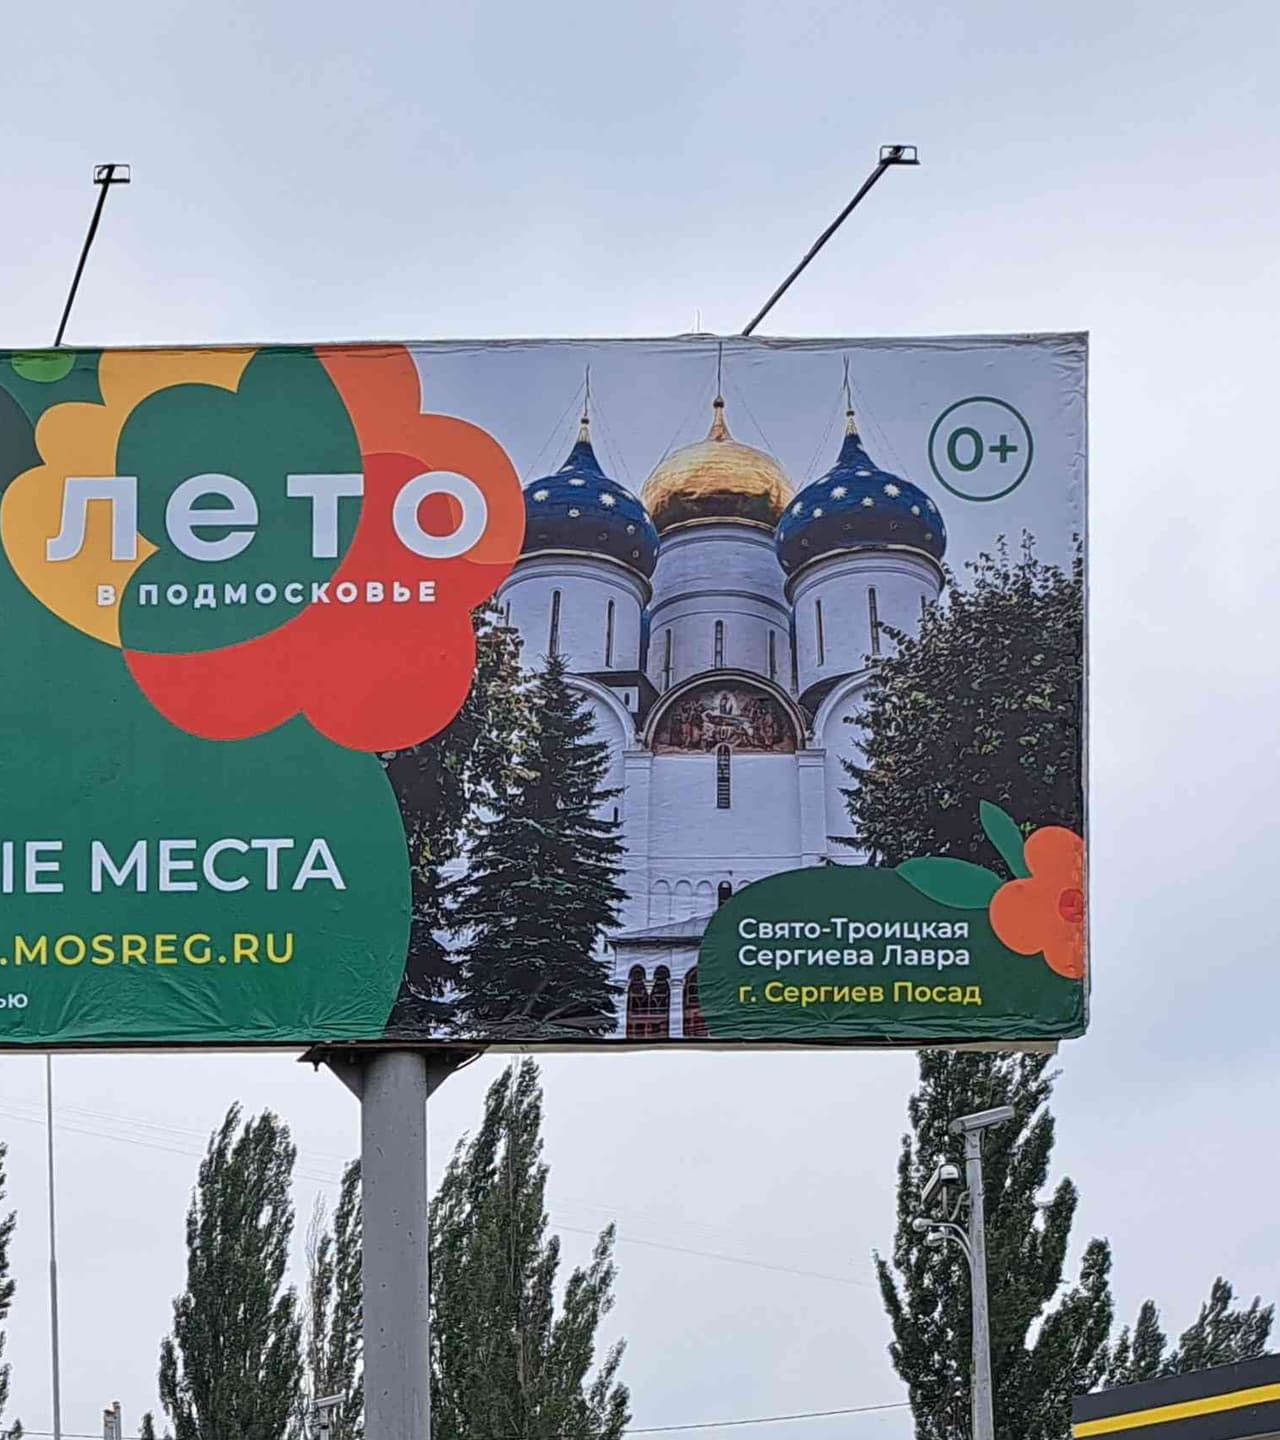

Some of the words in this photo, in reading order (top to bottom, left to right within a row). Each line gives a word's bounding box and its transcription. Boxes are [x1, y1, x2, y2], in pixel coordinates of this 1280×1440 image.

[947, 426, 1018, 472] 0+
[45, 469, 489, 563] лето
[138, 580, 437, 609] ПОДМОСКОВЬЕ
[90, 836, 347, 894] МЕСТА
[738, 917, 969, 944] Свято-Троицкая
[738, 945, 874, 971] Сергиева
[881, 945, 970, 971] Лавра
[738, 983, 757, 1002] г.
[764, 982, 885, 1007] Сергиев
[893, 981, 982, 1006] Посад
